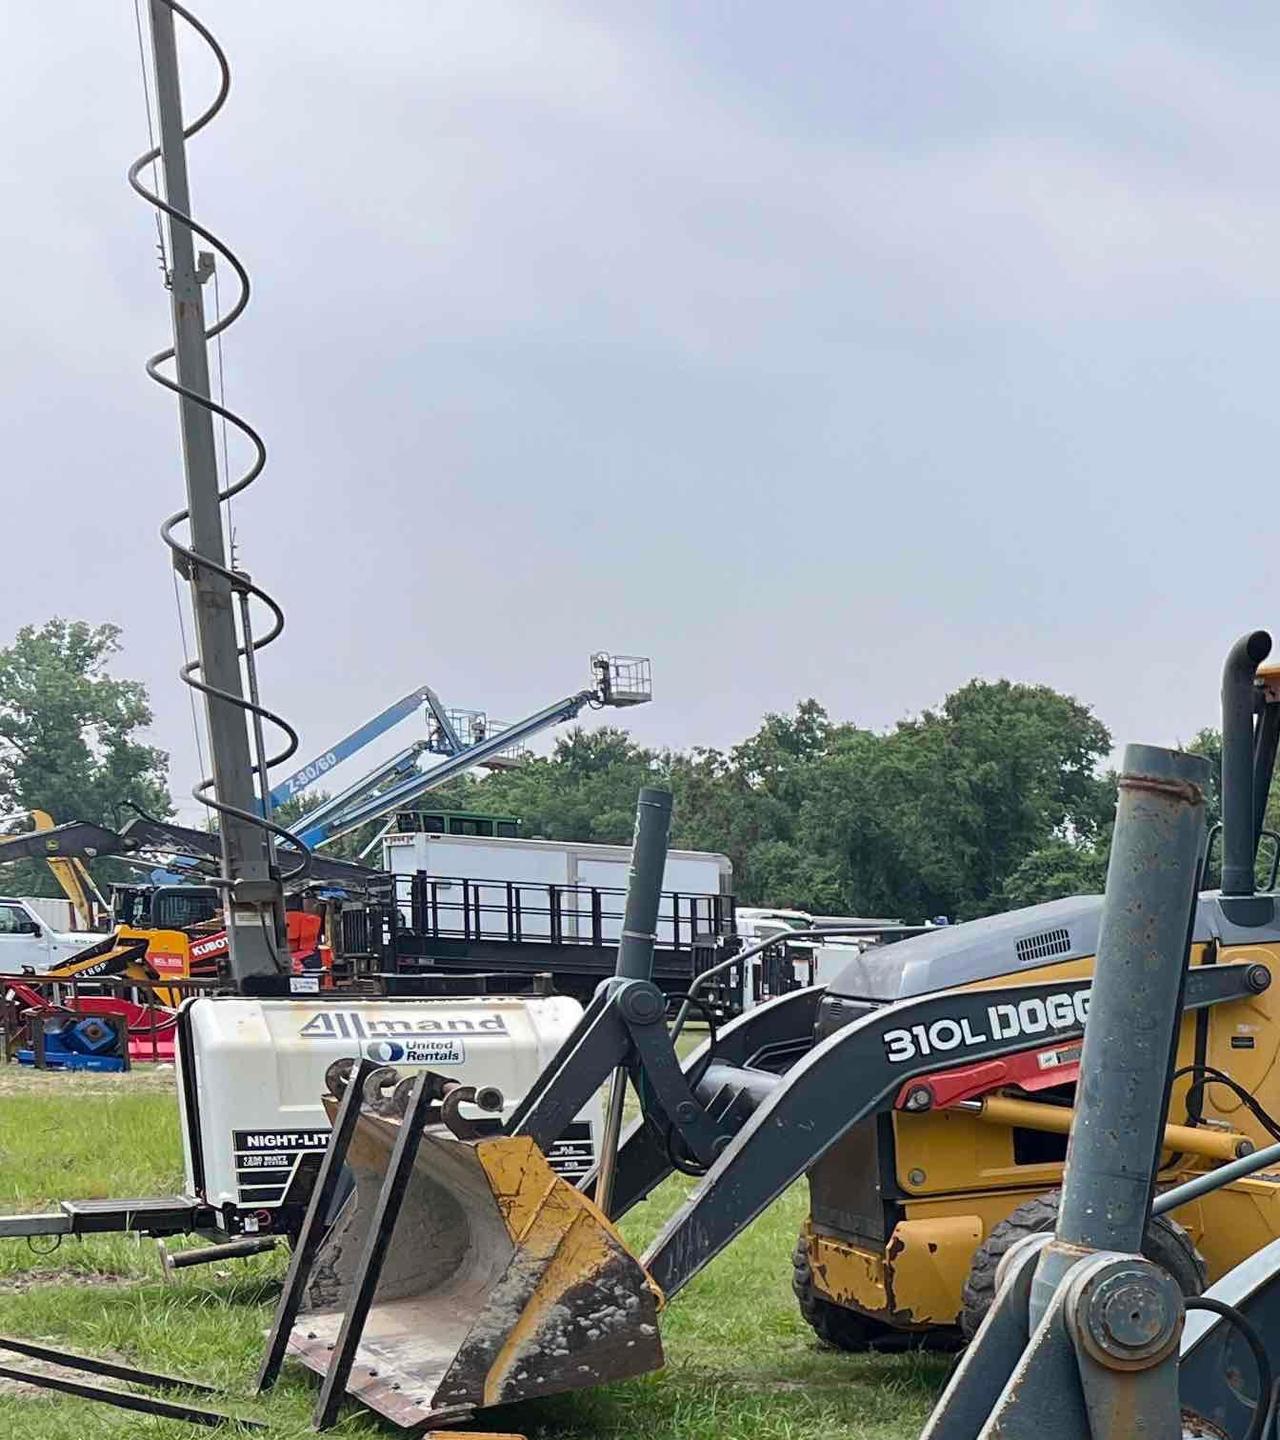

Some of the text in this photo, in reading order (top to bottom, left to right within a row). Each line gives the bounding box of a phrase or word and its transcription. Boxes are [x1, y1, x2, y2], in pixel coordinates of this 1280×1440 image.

[300, 1012, 509, 1039] Allmand
[406, 1040, 454, 1051] United
[882, 1018, 987, 1063] 310L
[406, 1051, 460, 1062] Rentals
[246, 1133, 332, 1148] NIGHT-LIT
